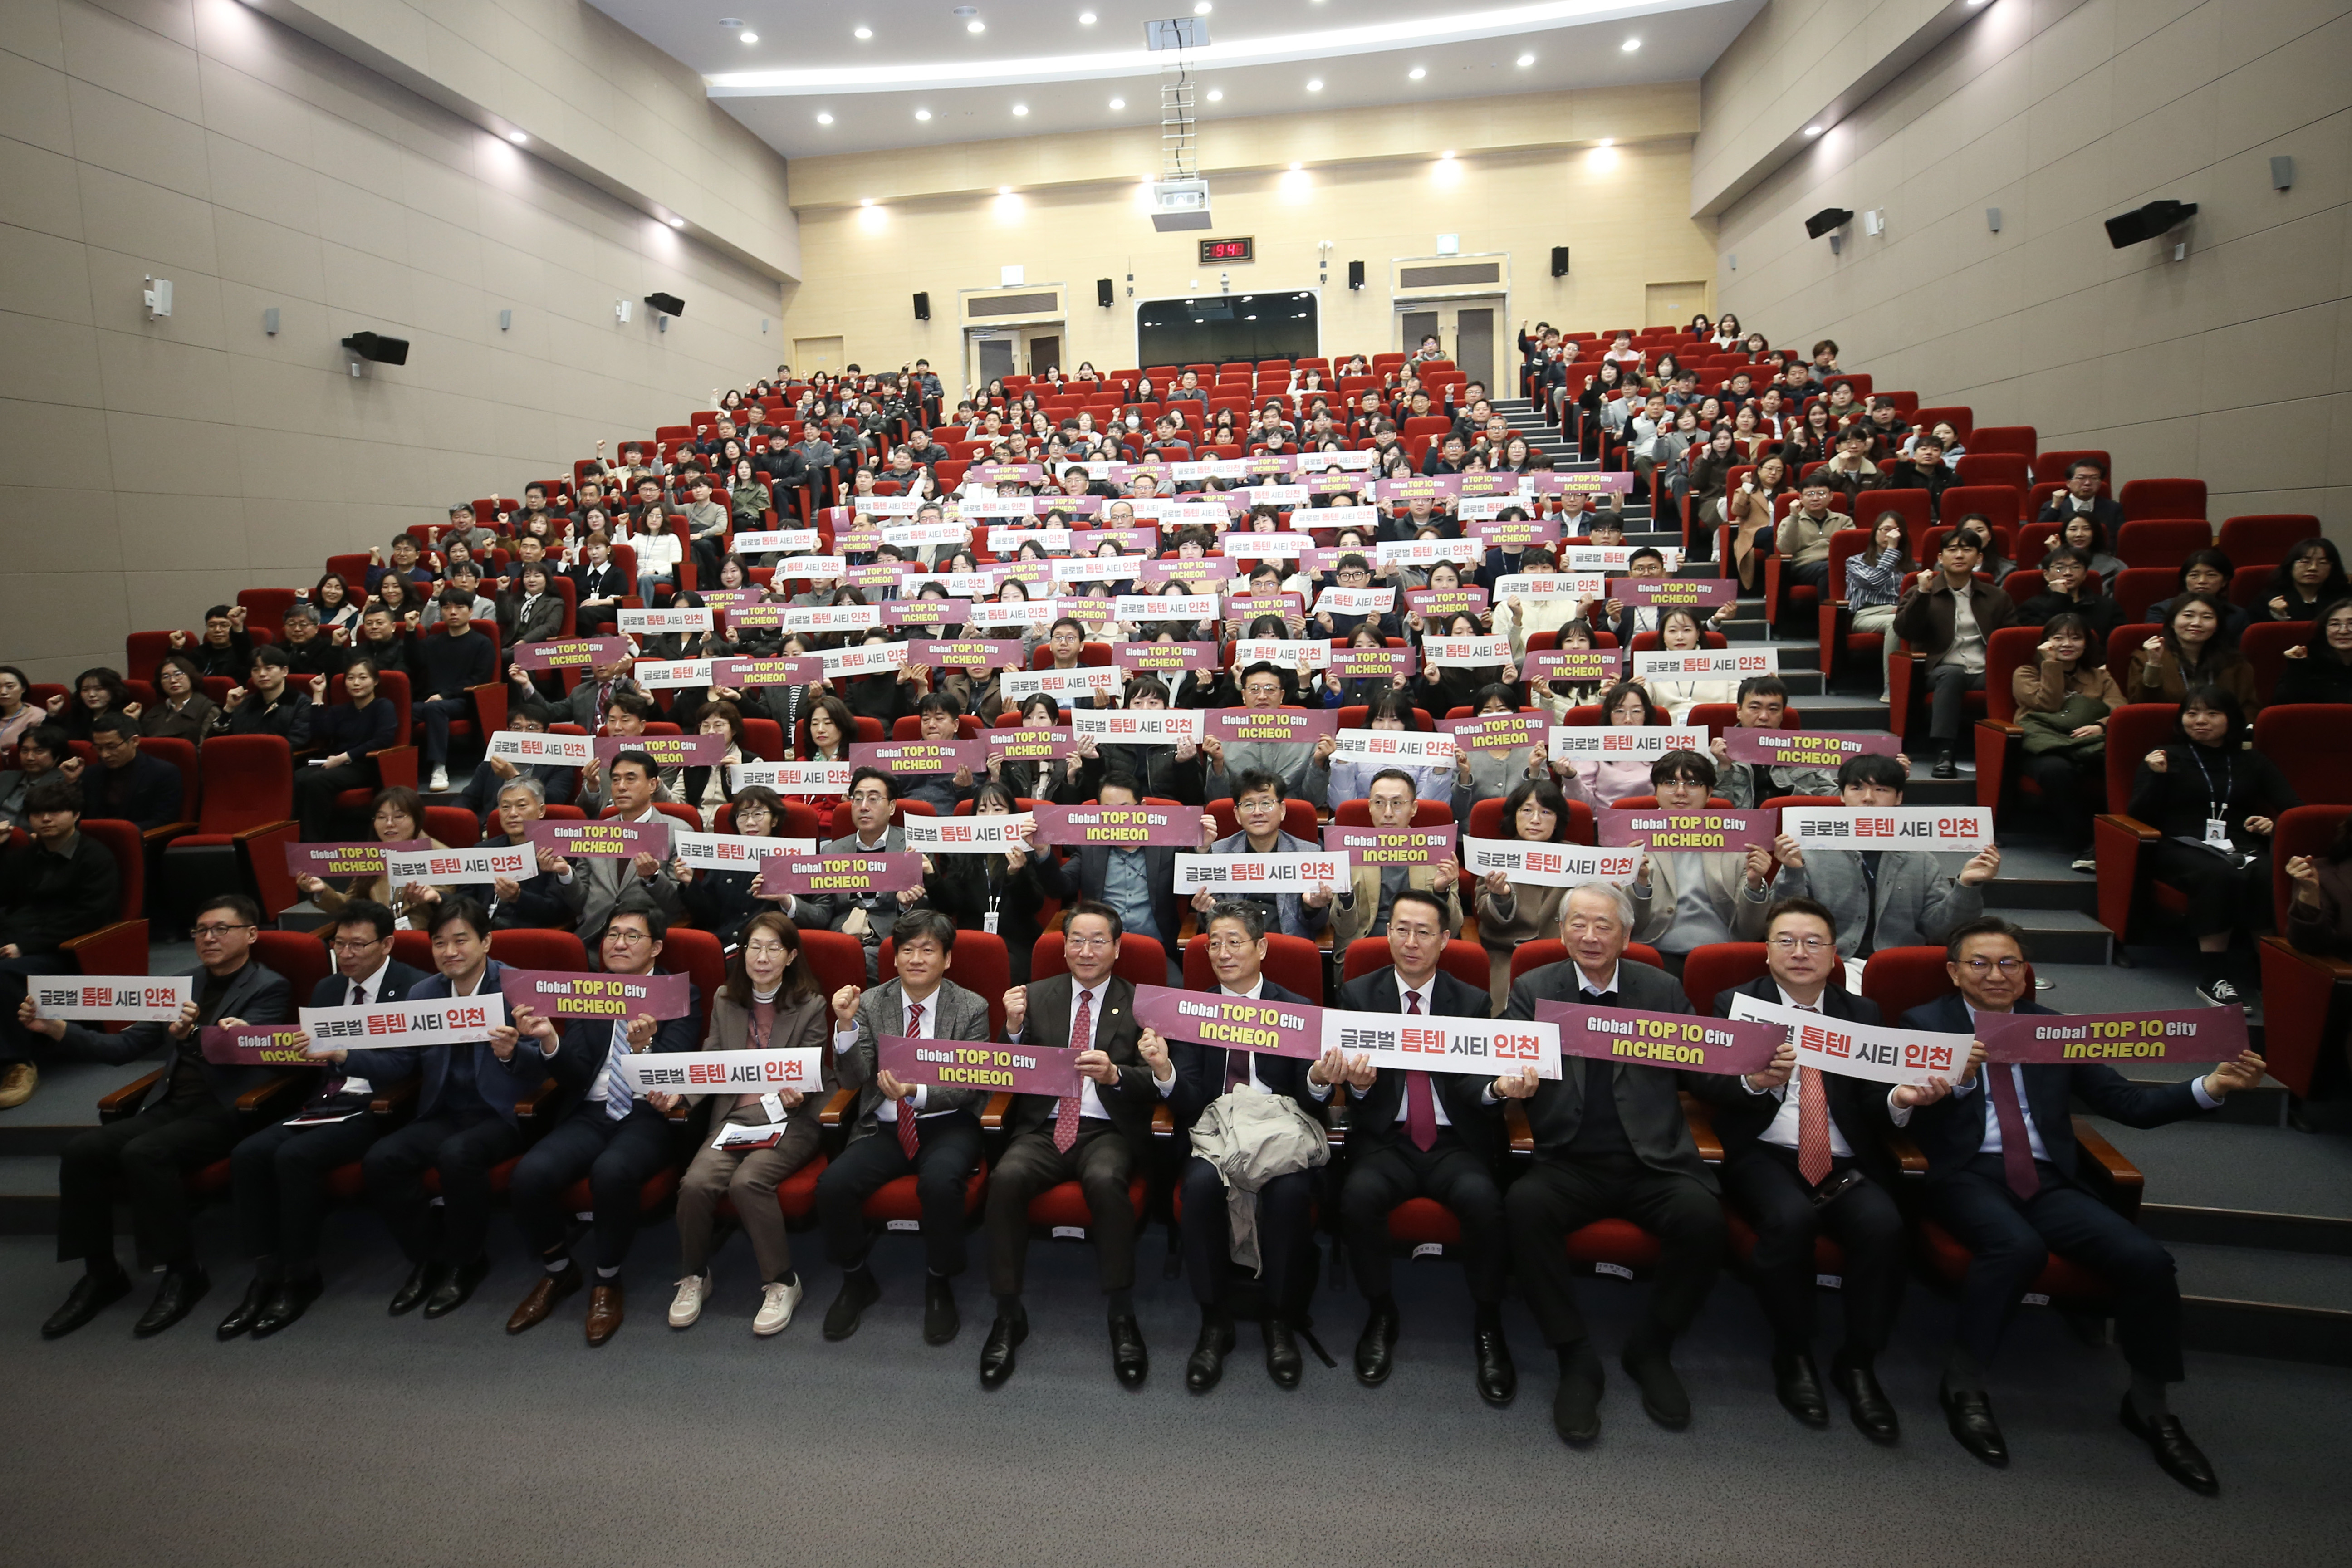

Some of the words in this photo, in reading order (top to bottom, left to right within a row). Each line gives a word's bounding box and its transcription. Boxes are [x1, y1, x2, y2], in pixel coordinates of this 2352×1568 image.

[1481, 526, 1501, 534] Global
[740, 538, 761, 547] 글로벌
[762, 536, 778, 546] 톱텐
[794, 535, 810, 544] 인천
[1386, 549, 1410, 559] 글로벌
[1412, 546, 1432, 557] 톱텐
[1434, 547, 1450, 556] 시티
[1452, 544, 1473, 556] 인천
[1501, 583, 1529, 593] 글로벌
[1531, 580, 1554, 593] 톱텐
[1556, 582, 1575, 592] 시티
[1577, 579, 1599, 592] 인천
[1637, 584, 1662, 592] Global
[1697, 584, 1713, 593] City
[890, 605, 910, 613] Global
[937, 604, 950, 612] City
[623, 617, 645, 626] 글로벌
[647, 615, 666, 626] 톱텐
[667, 616, 683, 625] 시티
[684, 614, 704, 625] 인천
[534, 647, 557, 656] Global
[549, 654, 592, 665] INCHEON
[1646, 661, 1680, 673] 글로벌
[1683, 657, 1710, 672] 톱텐
[1713, 659, 1735, 671] 시티
[1739, 656, 1766, 671] 인천
[1010, 680, 1039, 692] 글로벌
[1041, 676, 1065, 690] 톱텐
[1067, 677, 1086, 688] 시티
[1088, 674, 1112, 686] 인천
[1076, 719, 1106, 733] 글로벌
[1109, 718, 1137, 733] 톱텐
[1139, 721, 1162, 733] 시티
[1165, 718, 1192, 734] 인천
[990, 734, 1014, 744] Global
[1014, 731, 1037, 743] TOP
[1037, 731, 1051, 742] 10
[1051, 733, 1067, 742] City
[1758, 736, 1791, 747] Global
[1792, 736, 1823, 749] TOP
[1823, 738, 1840, 750] 10
[1841, 740, 1862, 753] City
[494, 741, 519, 754] 글로벌
[520, 740, 543, 755] 톱텐
[545, 744, 562, 755] 시티
[563, 743, 586, 757] 인천
[1005, 745, 1052, 756] INCHEON
[1776, 750, 1842, 765] INCHEON
[1068, 813, 1099, 824] Global
[1101, 811, 1130, 824] TOP
[1131, 812, 1147, 824] 10
[1147, 813, 1167, 826] City
[554, 827, 582, 838] Global
[583, 826, 608, 838] TOP
[608, 826, 622, 838] 10
[622, 828, 638, 840] City
[1087, 827, 1149, 841] INCHEON
[1800, 821, 1849, 837] 글로벌
[1854, 818, 1895, 837] 톱텐
[1899, 821, 1932, 838] 시티
[1938, 818, 1979, 838] 인천
[570, 840, 624, 853] INCHEON
[1343, 834, 1377, 847] Global
[1378, 834, 1408, 847] TOP
[1410, 833, 1426, 846] 10
[1427, 835, 1447, 846] City
[1363, 849, 1428, 862] INCHEON
[1477, 851, 1521, 869] 글로벌
[1525, 852, 1562, 873] 톱텐
[1565, 859, 1596, 875] 시티
[1600, 857, 1634, 875] 인천
[392, 862, 428, 876] 글로벌
[430, 858, 462, 874] 톱텐
[465, 859, 489, 872] 시티
[491, 854, 523, 872] 인천
[1186, 867, 1227, 882] 글로벌
[1230, 863, 1265, 881] 톱텐
[1268, 865, 1296, 880] 시티
[1300, 862, 1334, 880] 인천
[39, 990, 78, 1006] 글로벌
[81, 987, 112, 1007] 톱텐
[115, 990, 141, 1007] 시티
[144, 988, 176, 1008] 인천
[536, 980, 571, 994] Global
[572, 980, 604, 995] TOP
[606, 981, 623, 996] 10
[624, 984, 647, 999] City
[557, 997, 627, 1014] INCHEON
[314, 1019, 364, 1038] 글로벌
[367, 1013, 407, 1035] 톱텐
[411, 1013, 443, 1031] 시티
[446, 1007, 486, 1029] 인천
[1178, 1000, 1219, 1019] Global
[1221, 1003, 1257, 1022] TOP
[1259, 1008, 1279, 1026] 10
[1279, 1013, 1305, 1030] City
[1199, 1021, 1279, 1048] INCHEON
[1587, 1016, 1633, 1035] Global
[1636, 1019, 1678, 1039] TOP
[1680, 1024, 1703, 1042] 10
[1705, 1029, 1734, 1047] City
[2036, 1025, 2087, 1039] Global
[2090, 1021, 2136, 1038] TOP
[2140, 1019, 2164, 1037] 10
[2166, 1021, 2197, 1036] City
[237, 1035, 271, 1047] Global
[272, 1032, 295, 1047] TO
[1340, 1028, 1395, 1051] 글로벌
[1401, 1028, 1445, 1054] 톱텐
[1450, 1035, 1488, 1057] 시티
[1493, 1034, 1539, 1060] 인천
[1800, 1025, 1852, 1059] 톱텐
[1855, 1043, 1899, 1067] 시티
[1904, 1044, 1953, 1071] 인천
[1612, 1039, 1704, 1065] INCHEON
[2063, 1041, 2166, 1058] INCHEON
[916, 1048, 954, 1063] Global
[956, 1049, 990, 1065] TOP
[992, 1051, 1011, 1067] 10
[1012, 1055, 1036, 1069] City
[639, 1068, 686, 1085] 글로벌
[688, 1063, 727, 1084] 톱텐
[730, 1065, 761, 1083] 시티
[764, 1060, 803, 1082] 인천
[939, 1067, 1014, 1086] INCHEON
